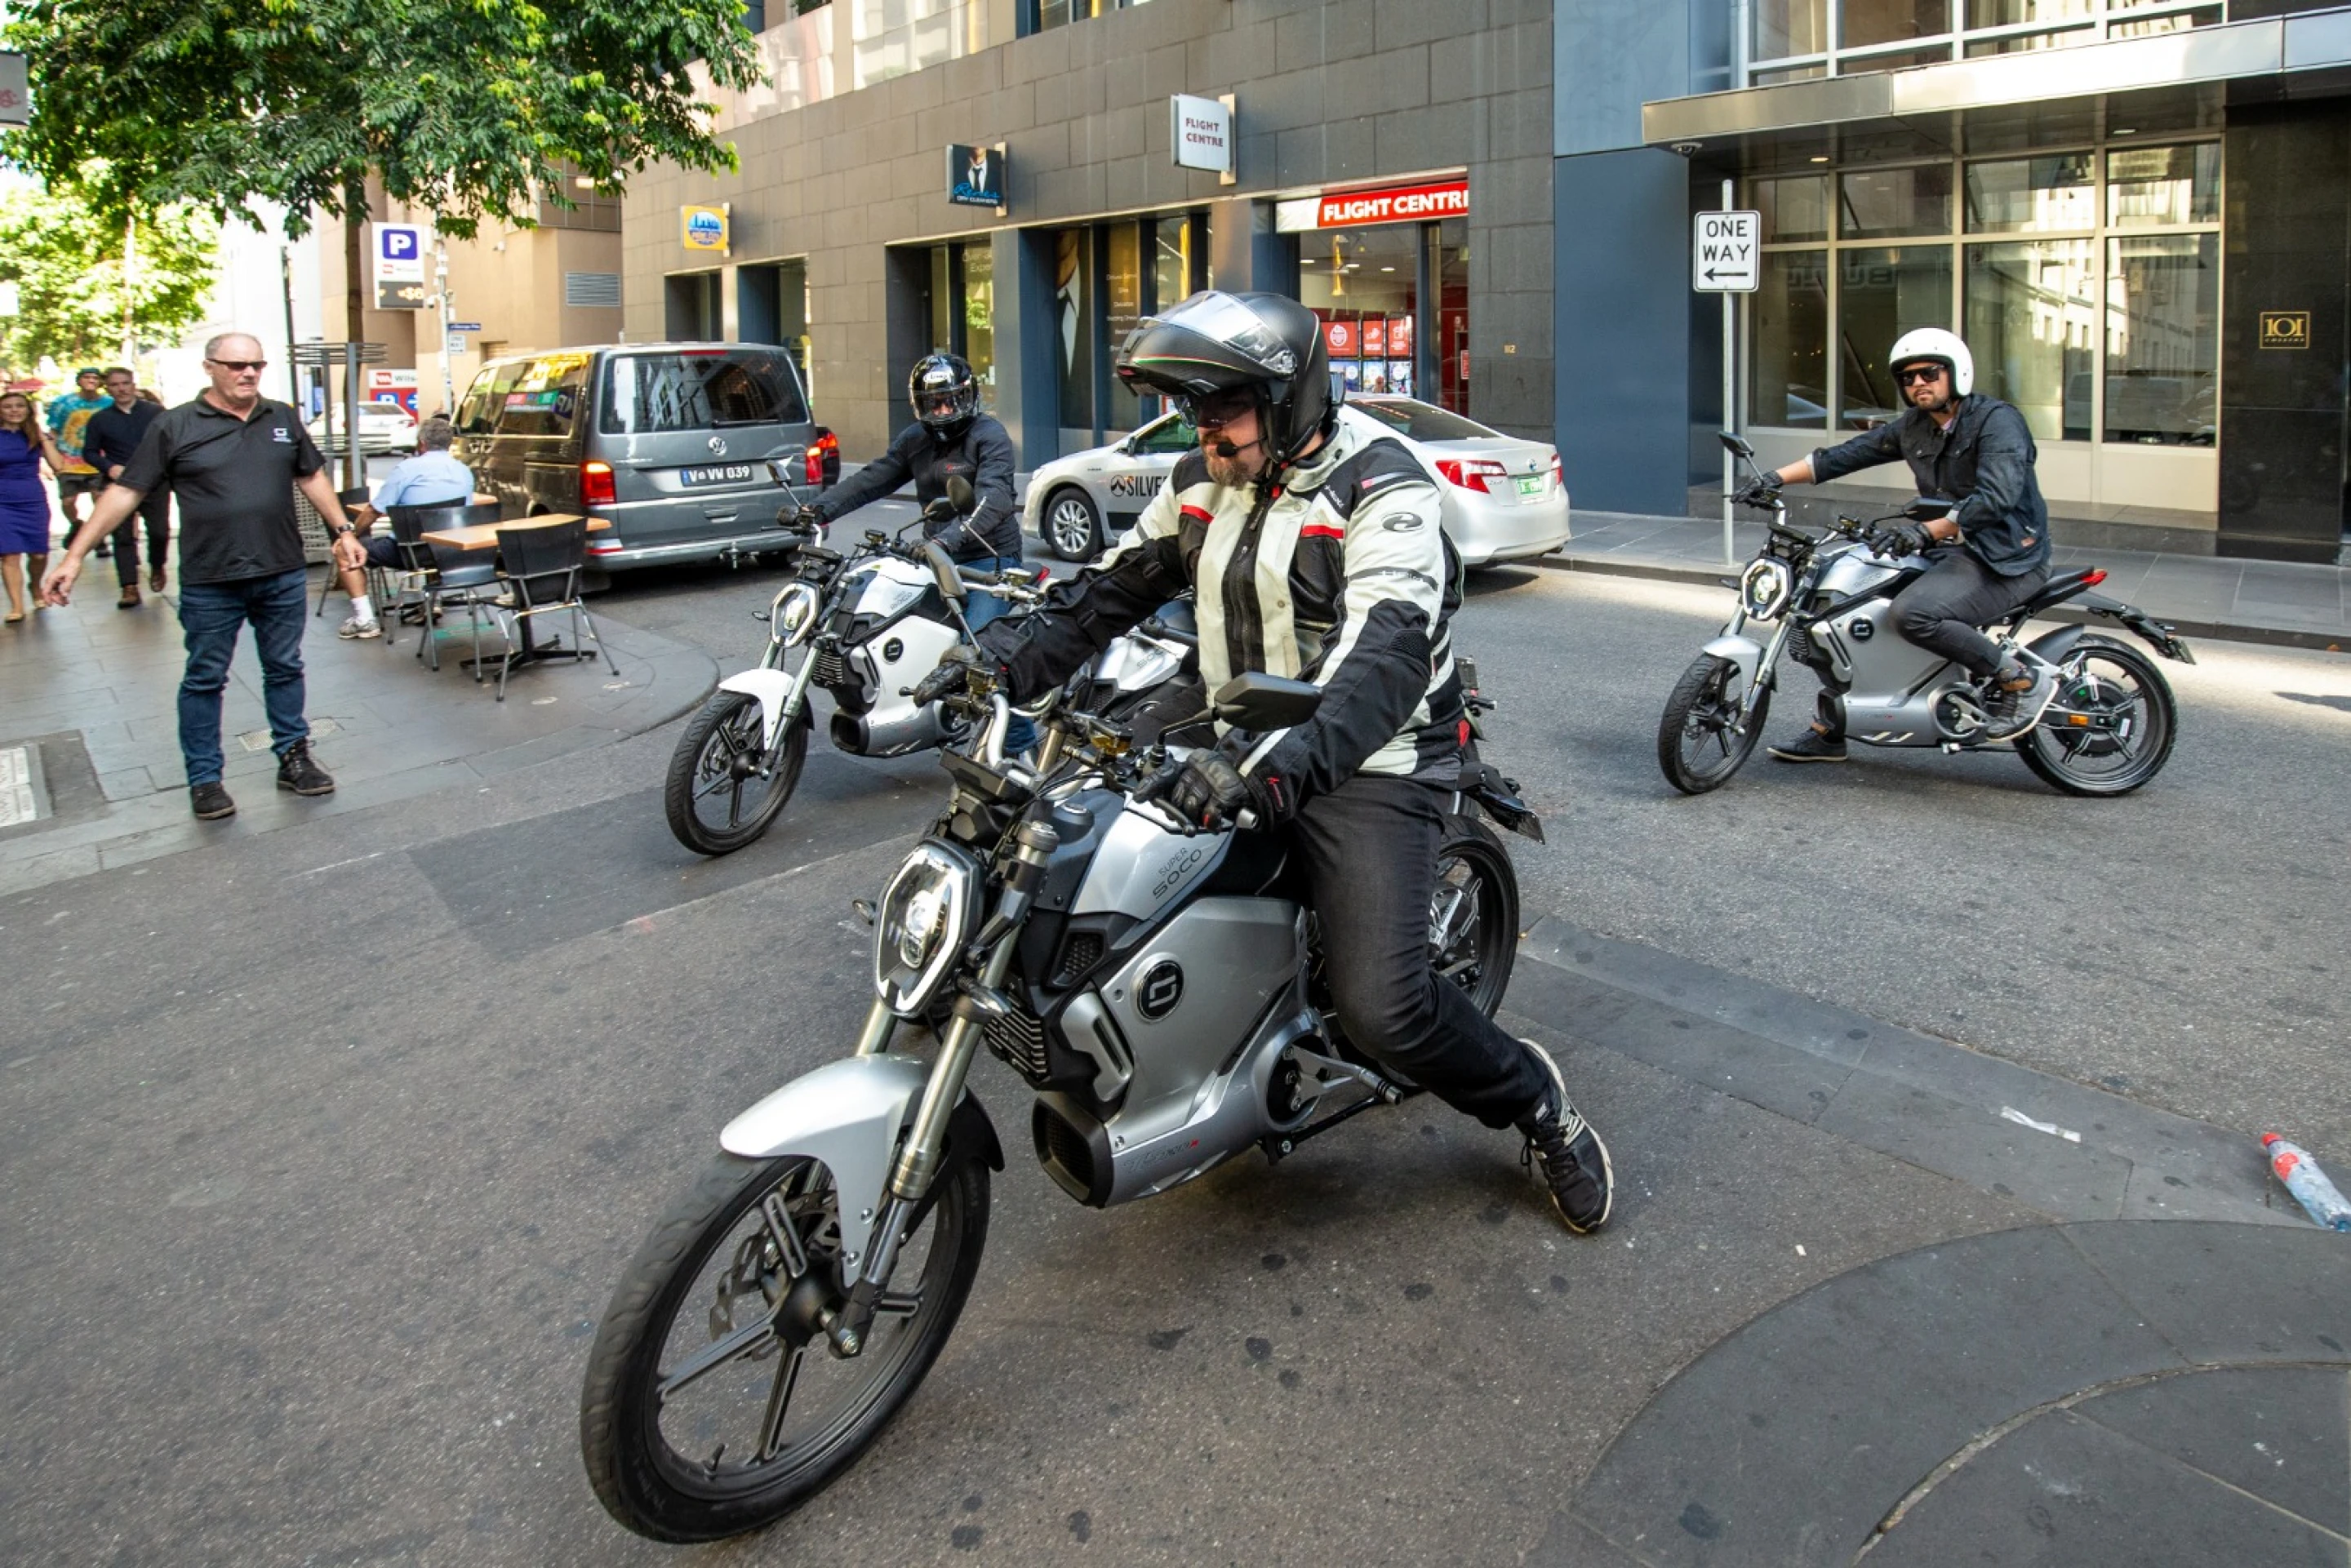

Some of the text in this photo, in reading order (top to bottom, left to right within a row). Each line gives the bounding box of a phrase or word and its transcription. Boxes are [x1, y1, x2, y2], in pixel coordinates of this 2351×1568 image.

[1185, 118, 1220, 132] FLIGHT
[1185, 132, 1224, 147] CENTRE
[1323, 198, 1391, 221] FLIGHT
[1706, 220, 1748, 238] ONE
[389, 233, 411, 255] P
[1702, 243, 1750, 262] WAY
[727, 465, 750, 479] 039
[1126, 475, 1168, 497] SILVE
[1158, 847, 1189, 877] SUPER
[1152, 848, 1202, 899] SOCO
